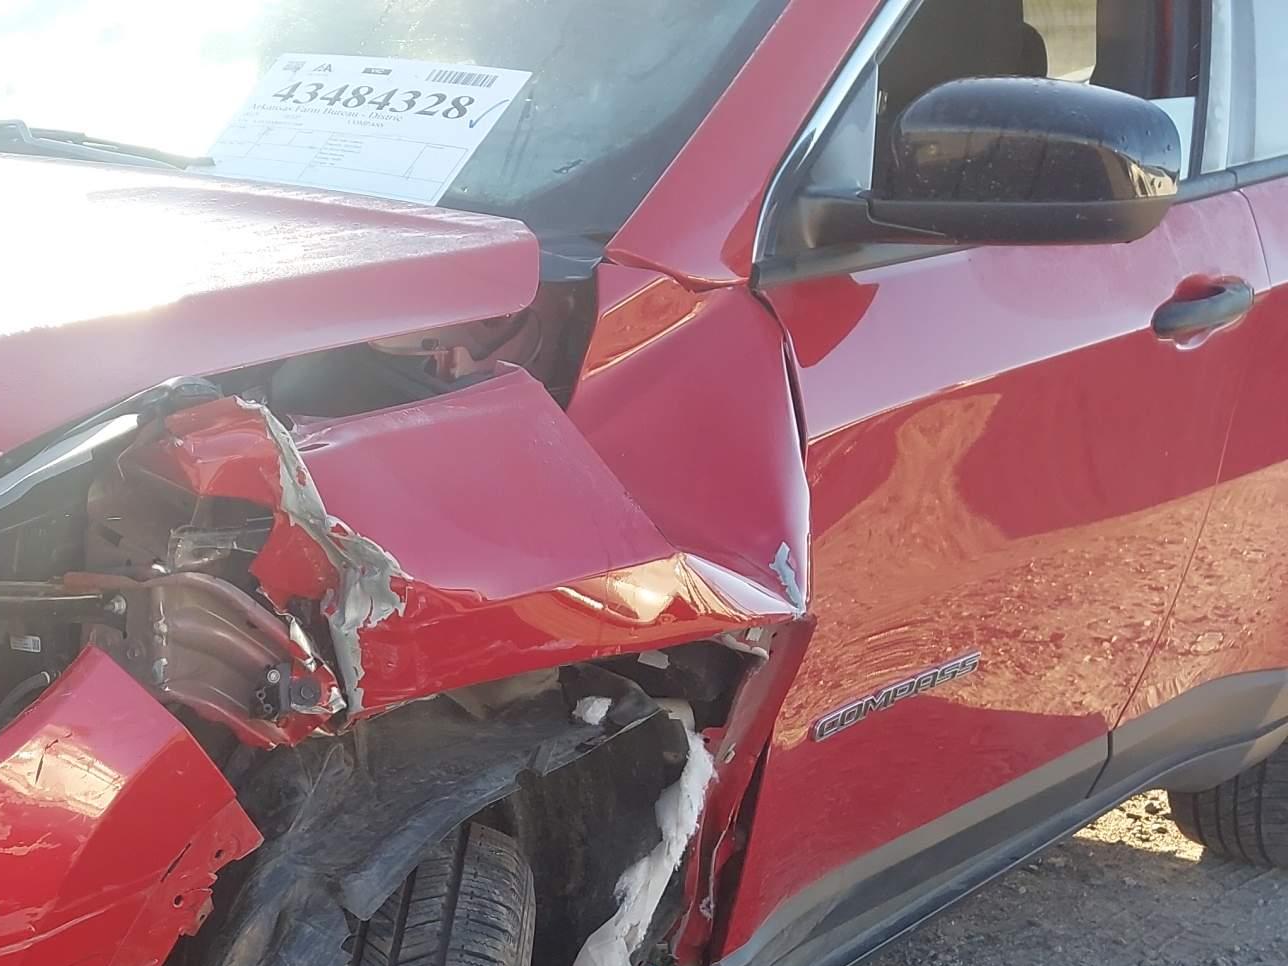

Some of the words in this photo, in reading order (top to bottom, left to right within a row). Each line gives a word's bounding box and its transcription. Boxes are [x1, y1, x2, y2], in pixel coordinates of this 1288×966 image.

[272, 80, 475, 119] 43484328
[295, 106, 321, 114] Farm
[814, 652, 981, 742] COMPASS
